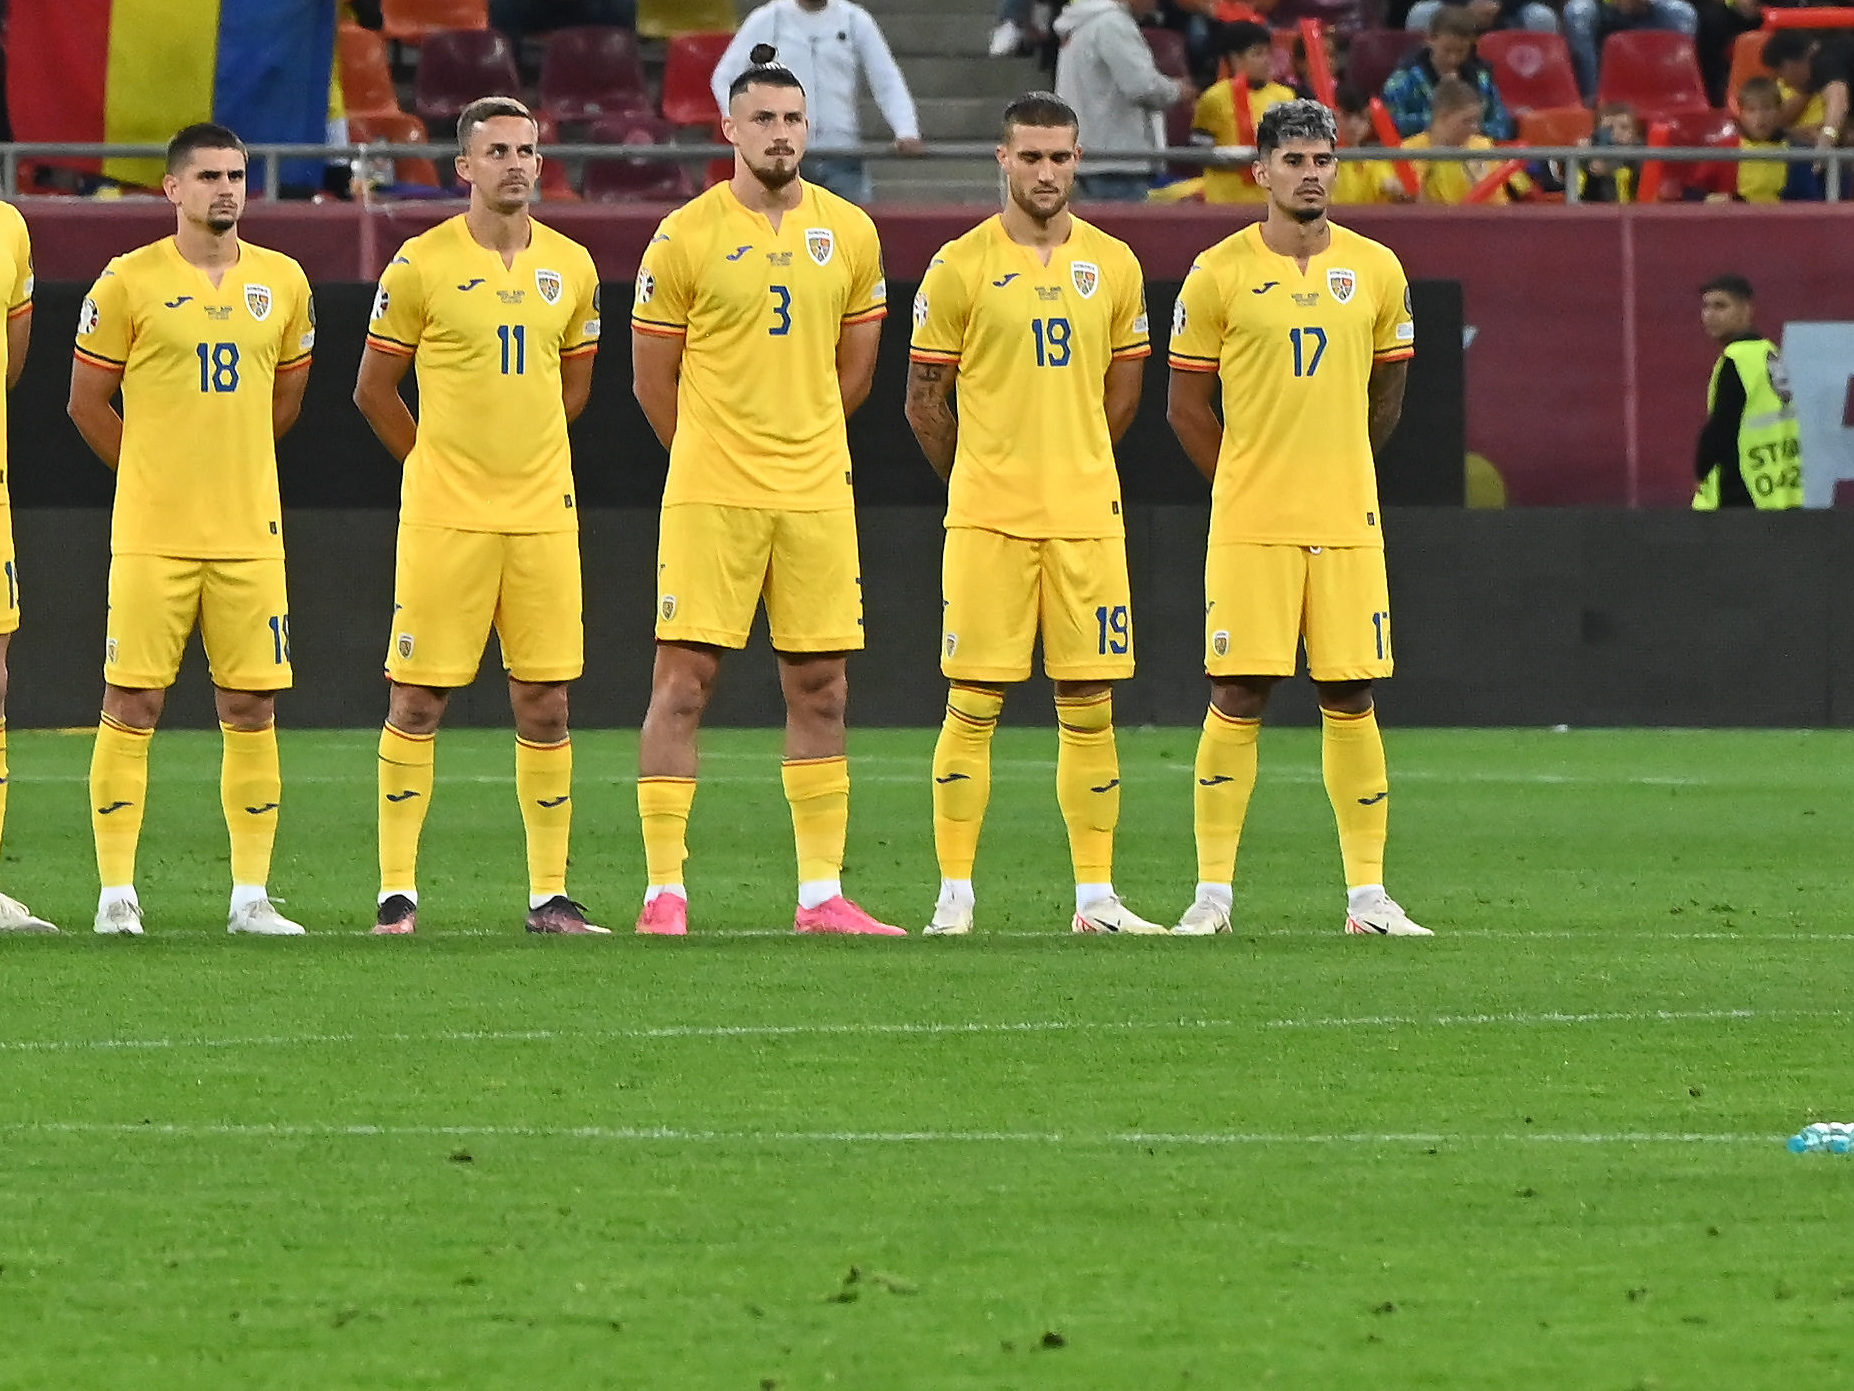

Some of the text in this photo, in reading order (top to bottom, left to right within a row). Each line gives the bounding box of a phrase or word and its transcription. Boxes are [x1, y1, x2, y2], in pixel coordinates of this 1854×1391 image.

[769, 285, 792, 335] 3
[496, 325, 525, 375] 11
[1031, 317, 1072, 367] 19
[1290, 327, 1328, 377] 17
[196, 342, 240, 393] 18
[1095, 605, 1129, 655] 19
